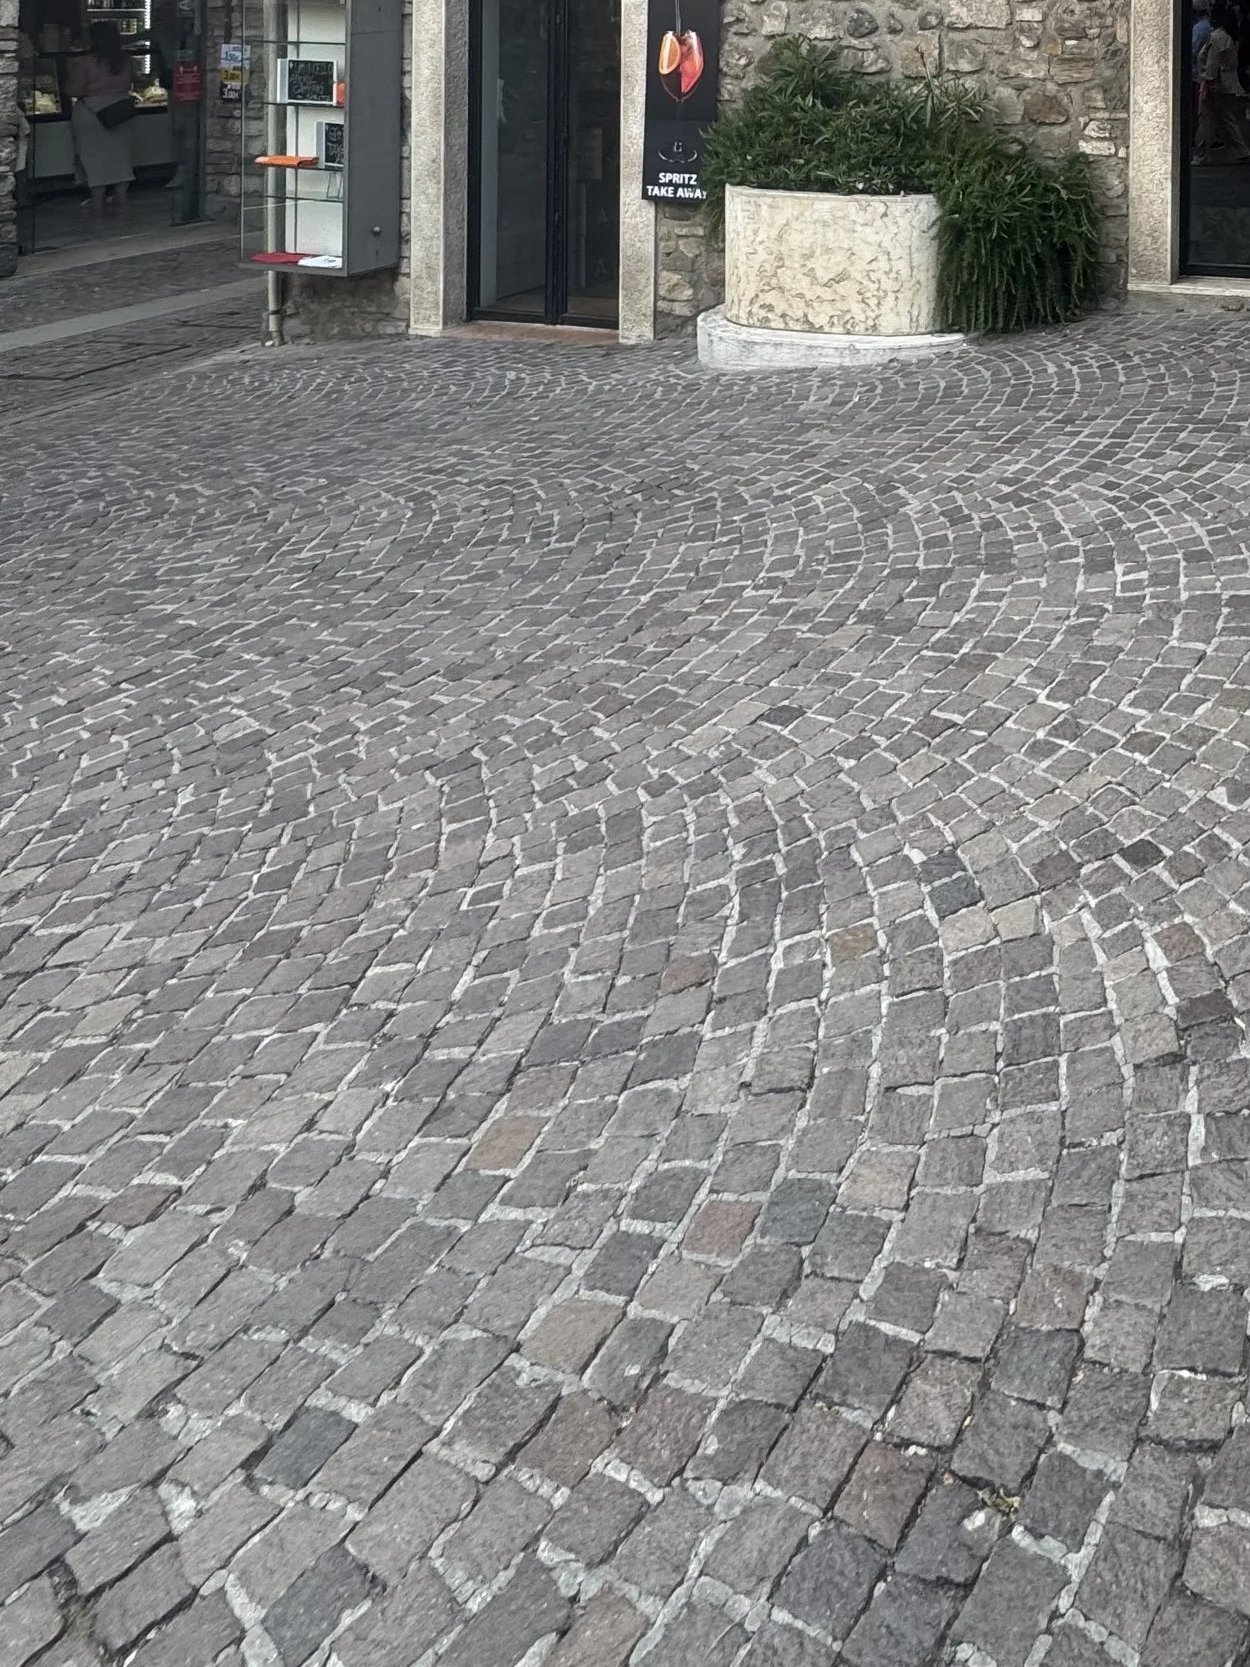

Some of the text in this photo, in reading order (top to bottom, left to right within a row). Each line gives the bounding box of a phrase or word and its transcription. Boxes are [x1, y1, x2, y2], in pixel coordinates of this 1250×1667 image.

[658, 173, 697, 185] SPRITZ
[646, 185, 707, 199] TAKE AWAY
